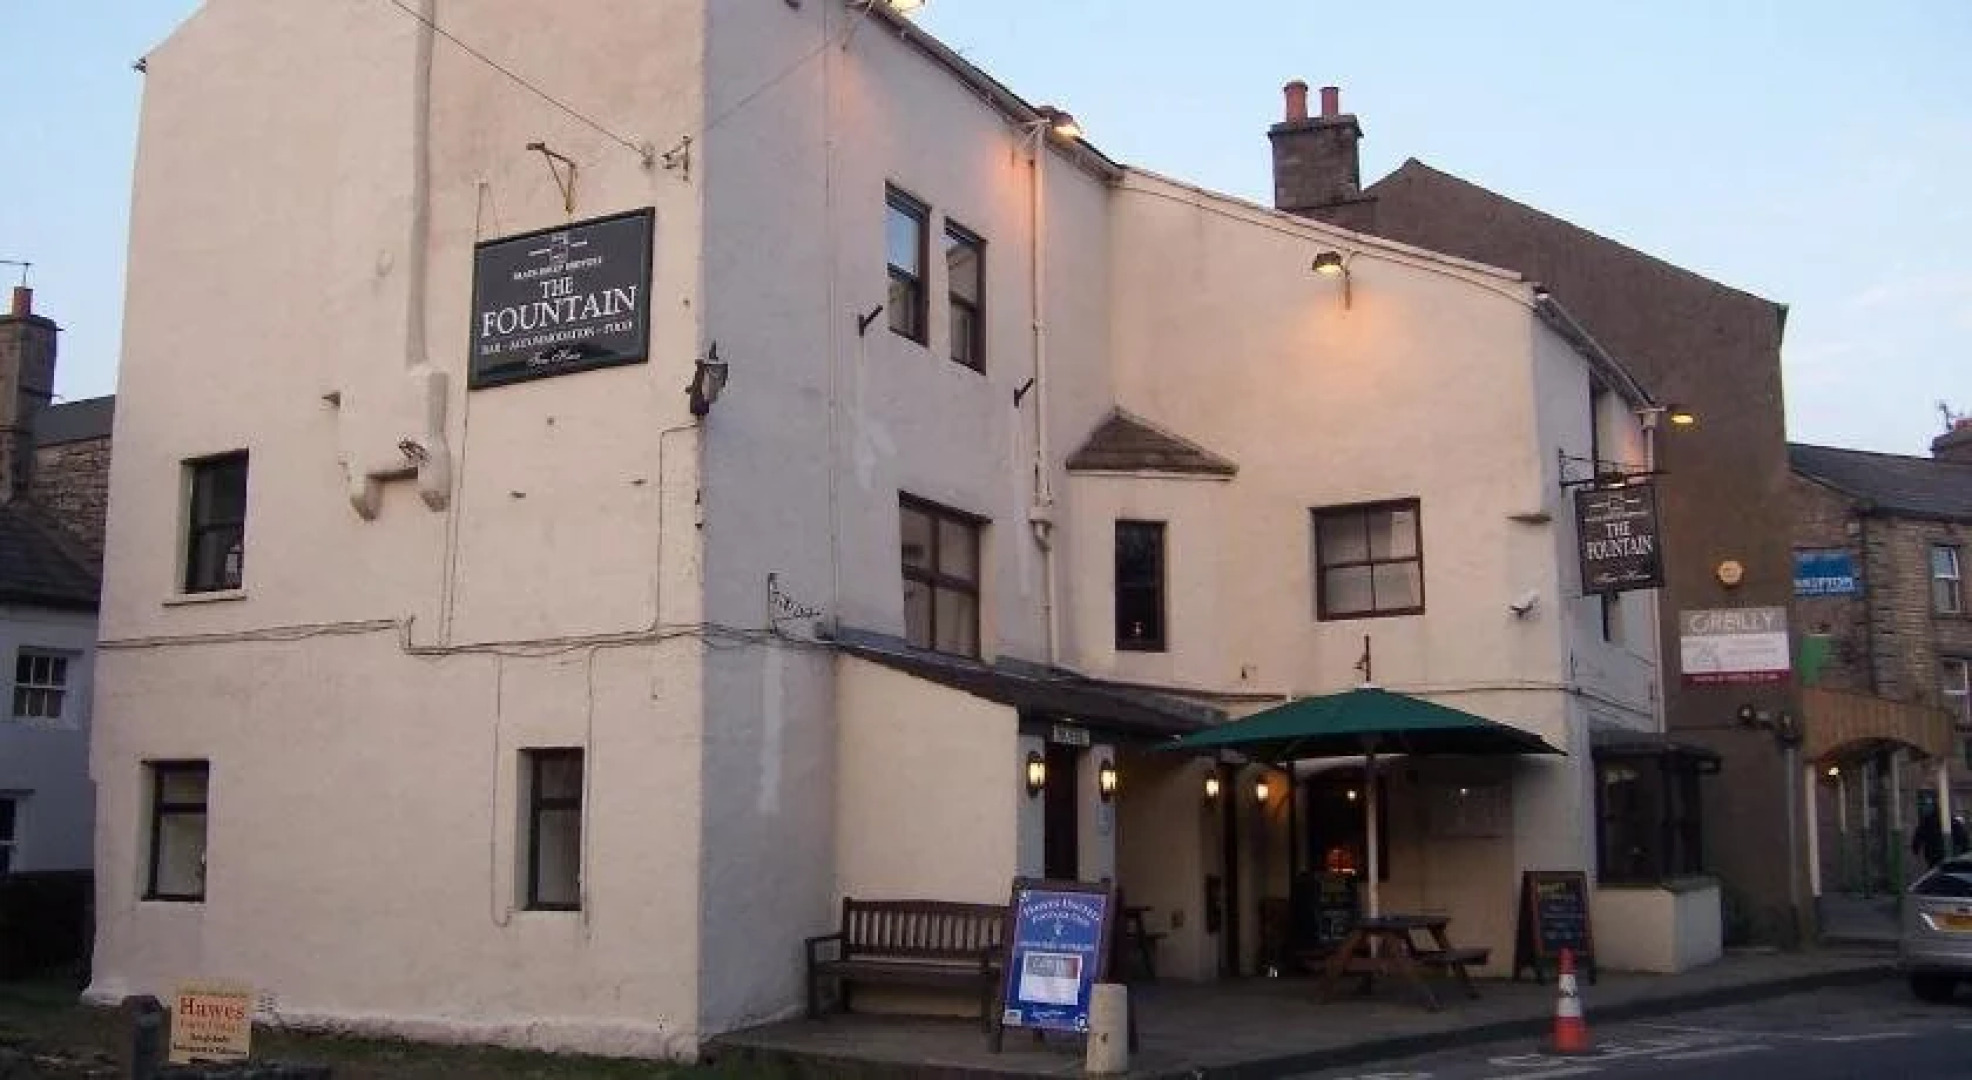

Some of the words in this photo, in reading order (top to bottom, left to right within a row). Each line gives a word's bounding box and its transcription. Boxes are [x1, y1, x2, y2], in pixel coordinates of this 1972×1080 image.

[539, 277, 574, 299] THE
[481, 285, 637, 337] FOUNTAIN
[1605, 520, 1631, 539] THE
[1586, 534, 1654, 560] FOUNTAIN
[180, 997, 245, 1019] Hawes
